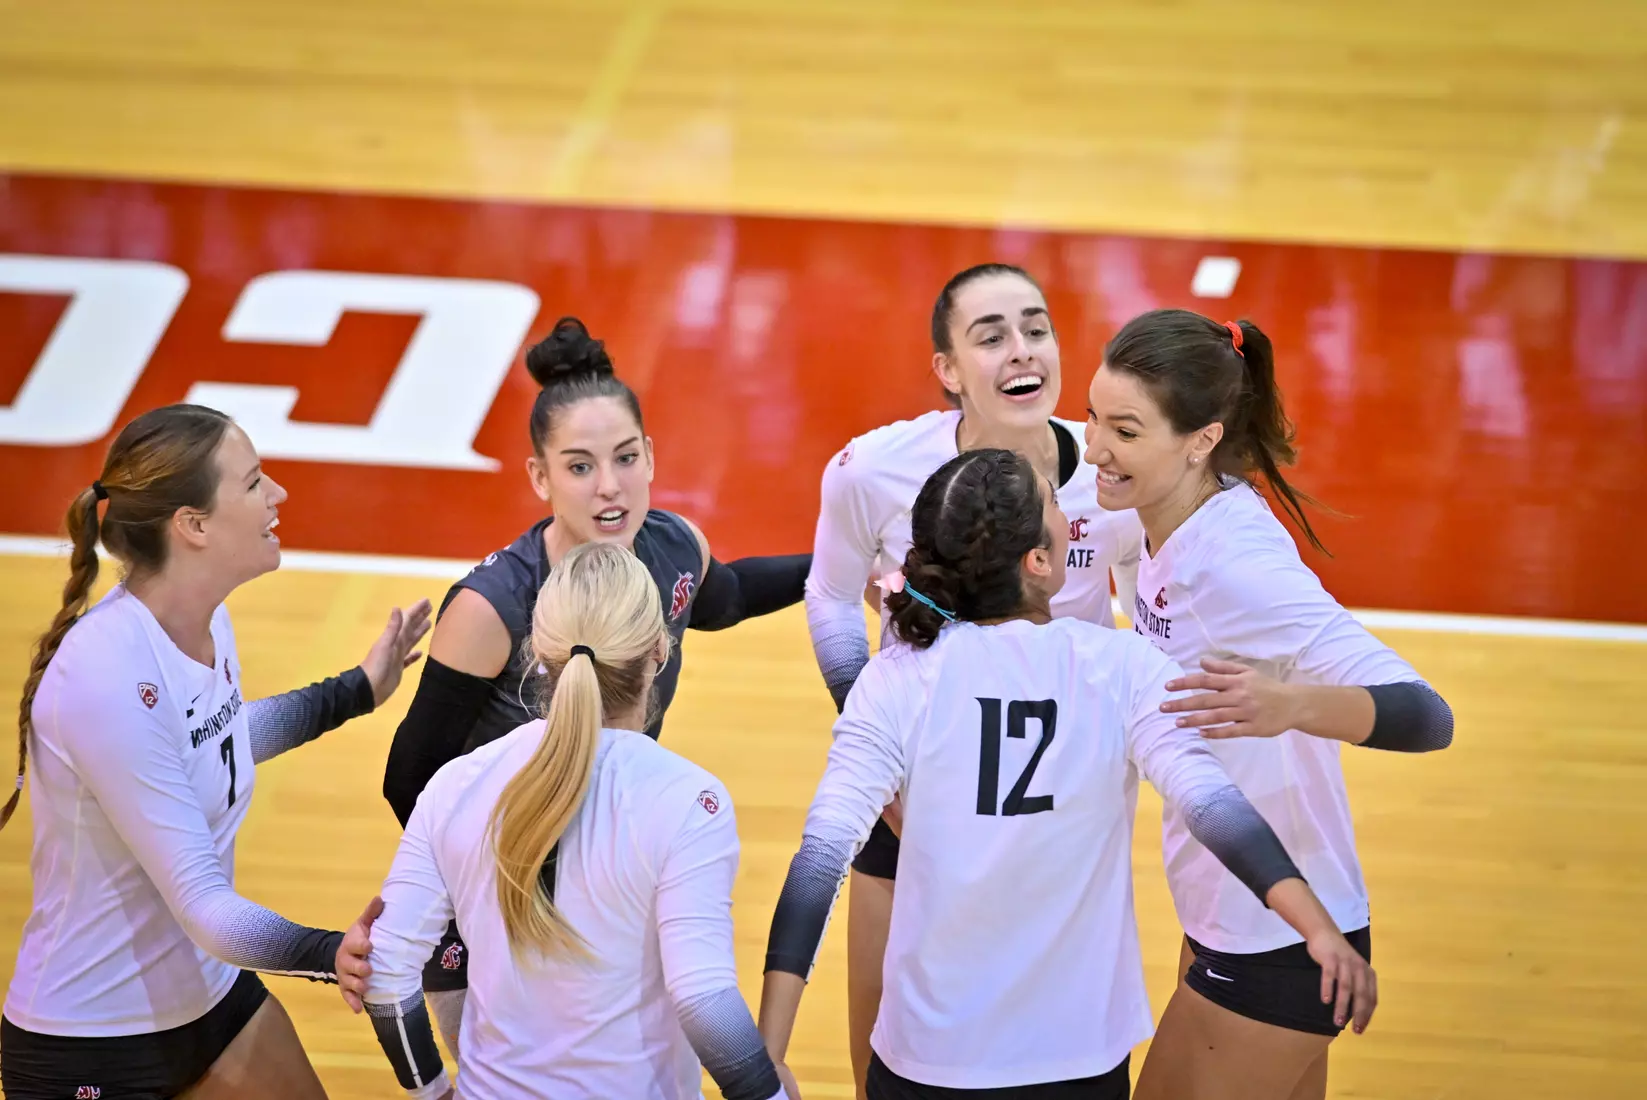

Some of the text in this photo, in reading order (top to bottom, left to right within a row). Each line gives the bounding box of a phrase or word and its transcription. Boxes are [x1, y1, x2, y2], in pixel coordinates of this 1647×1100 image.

[1066, 548, 1096, 569] ATE
[1148, 611, 1172, 640] STATE
[219, 732, 237, 812] 7
[974, 697, 1058, 817] 12
